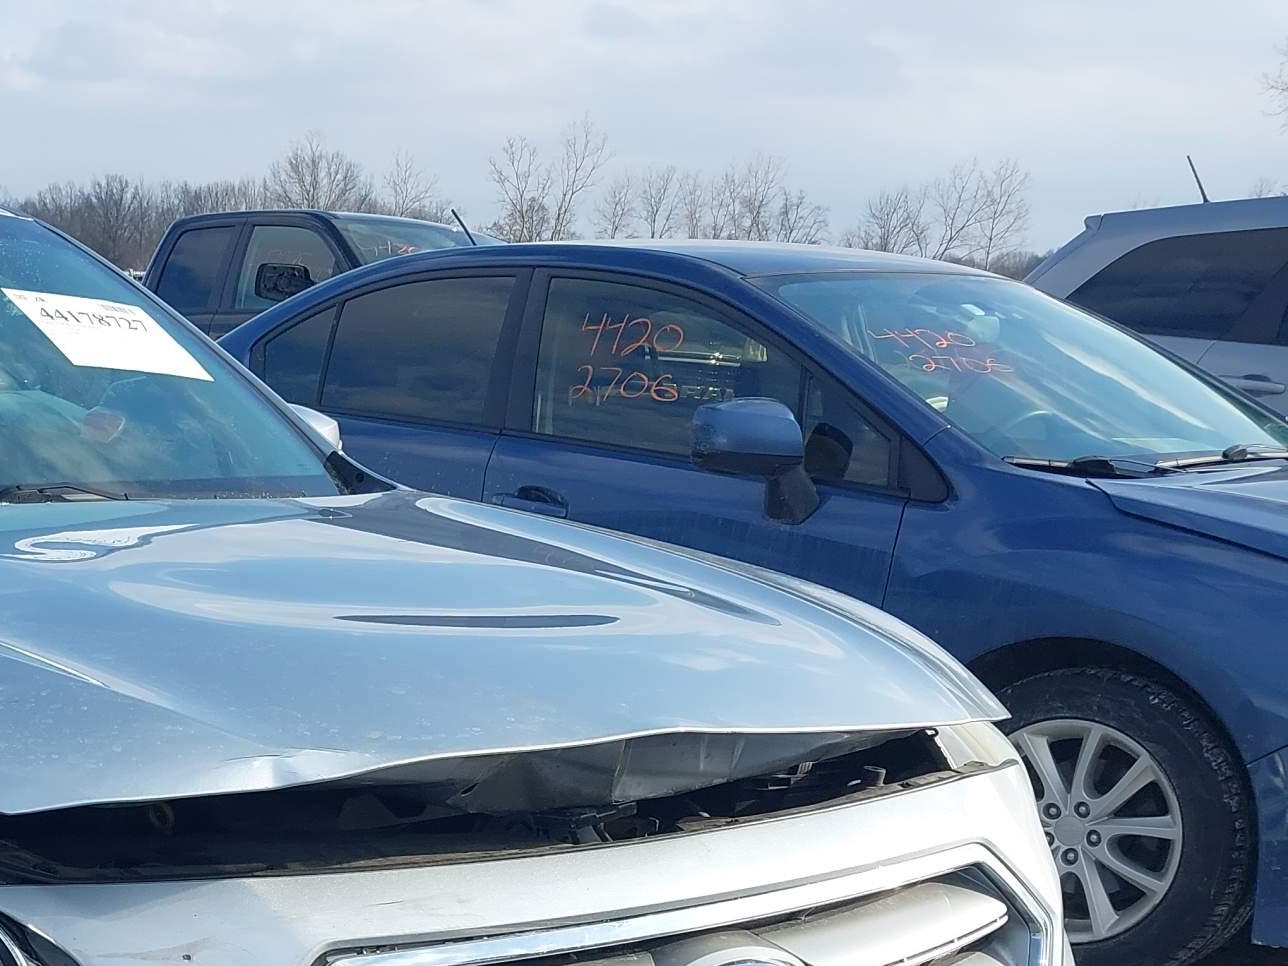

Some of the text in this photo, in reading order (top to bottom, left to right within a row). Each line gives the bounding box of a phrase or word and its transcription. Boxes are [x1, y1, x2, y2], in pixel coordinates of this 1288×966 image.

[40, 306, 148, 333] 44178727
[867, 328, 977, 353] 4420
[572, 365, 679, 402] 2706
